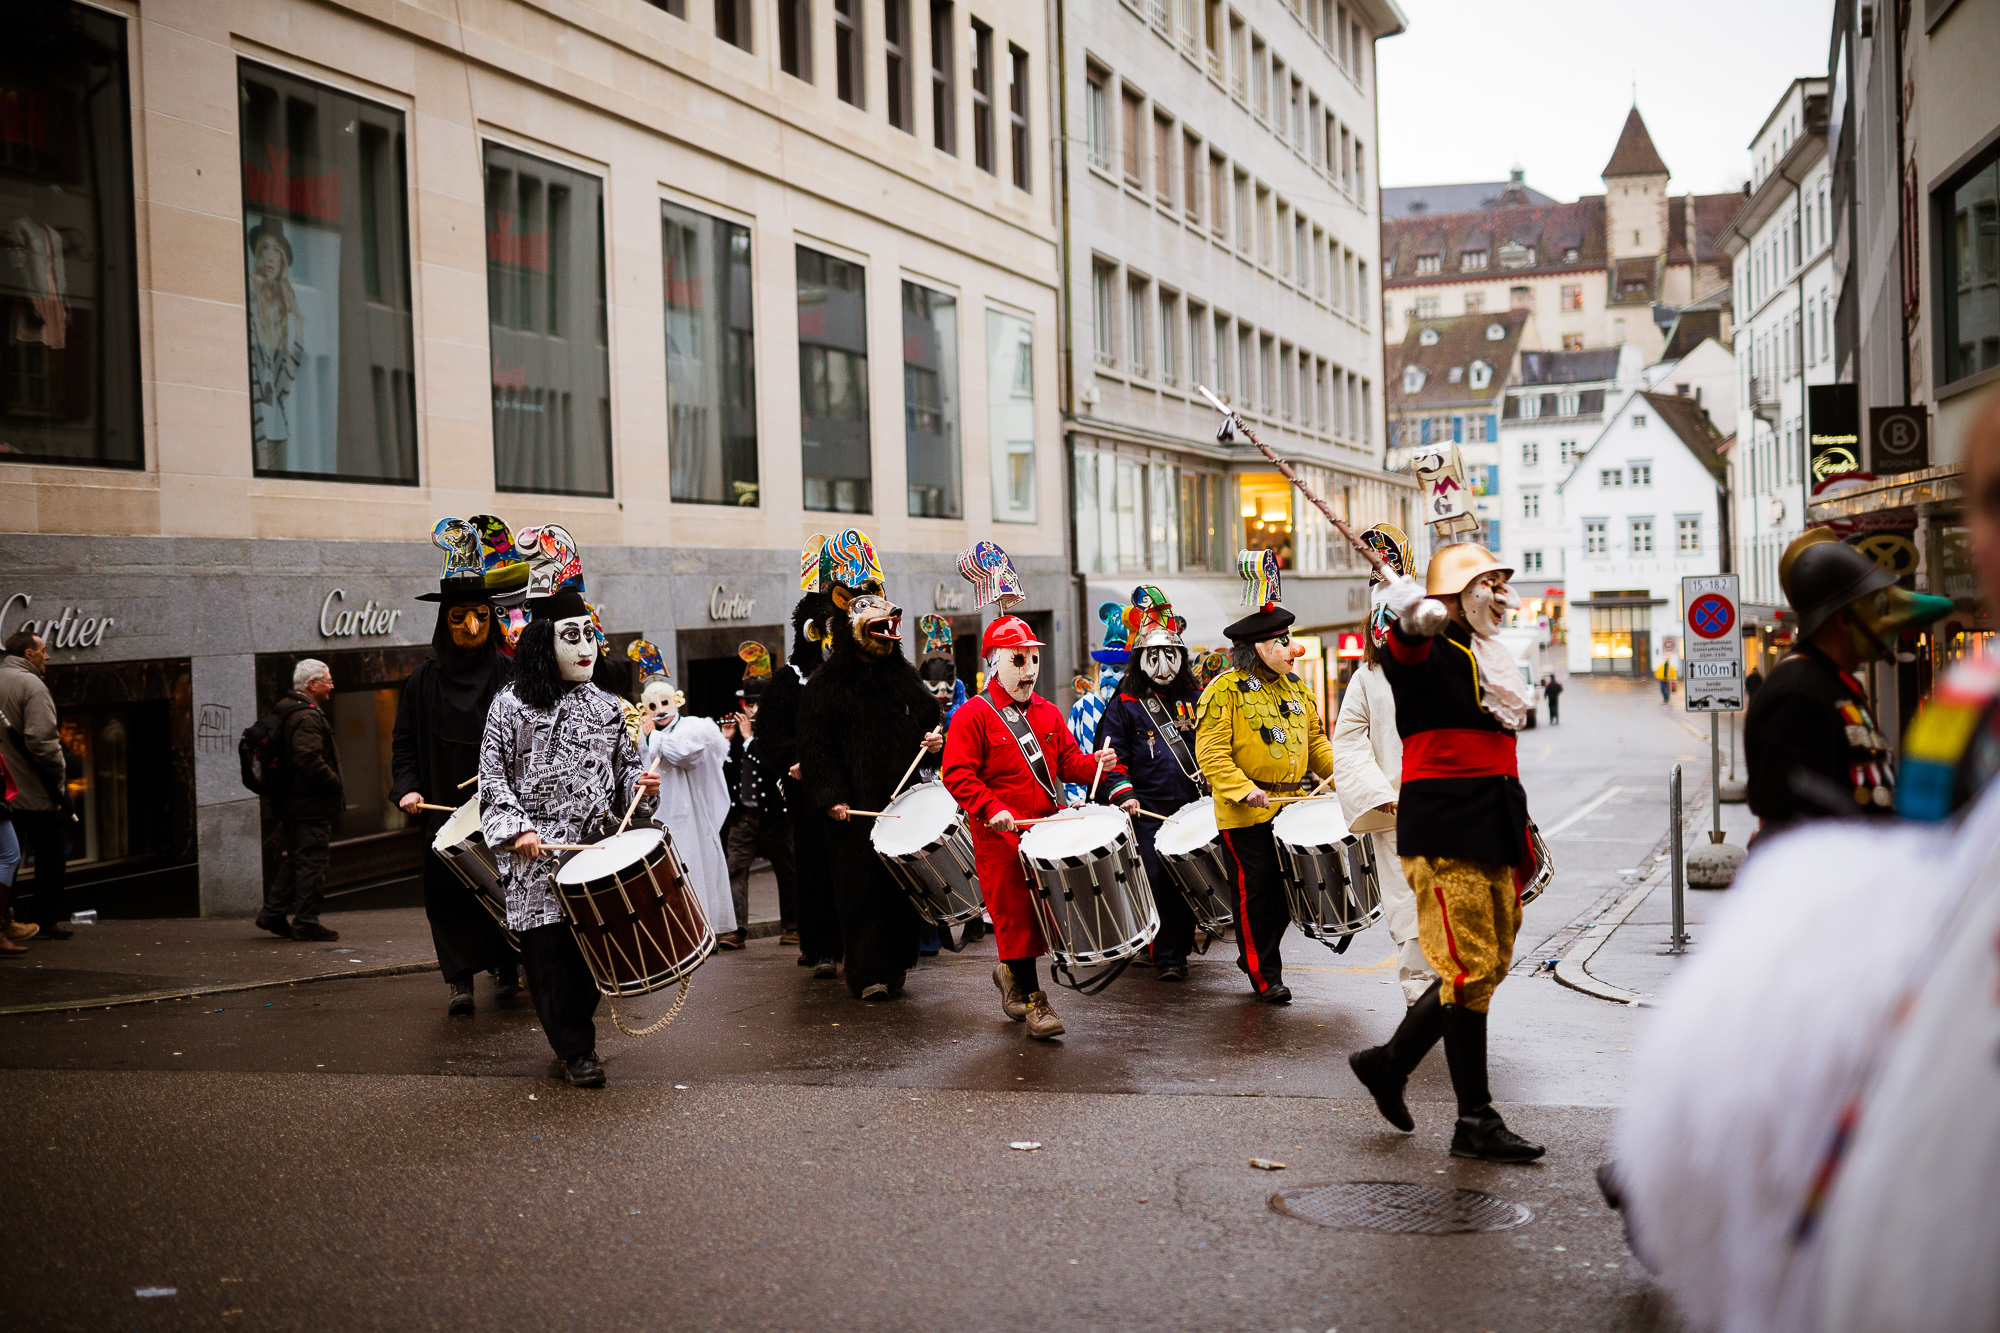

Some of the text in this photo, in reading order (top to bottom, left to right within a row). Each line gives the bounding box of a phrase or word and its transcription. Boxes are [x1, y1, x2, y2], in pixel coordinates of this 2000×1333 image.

[320, 588, 402, 637] Cartier
[711, 582, 757, 621] Cartier
[198, 710, 225, 733] ALDI
